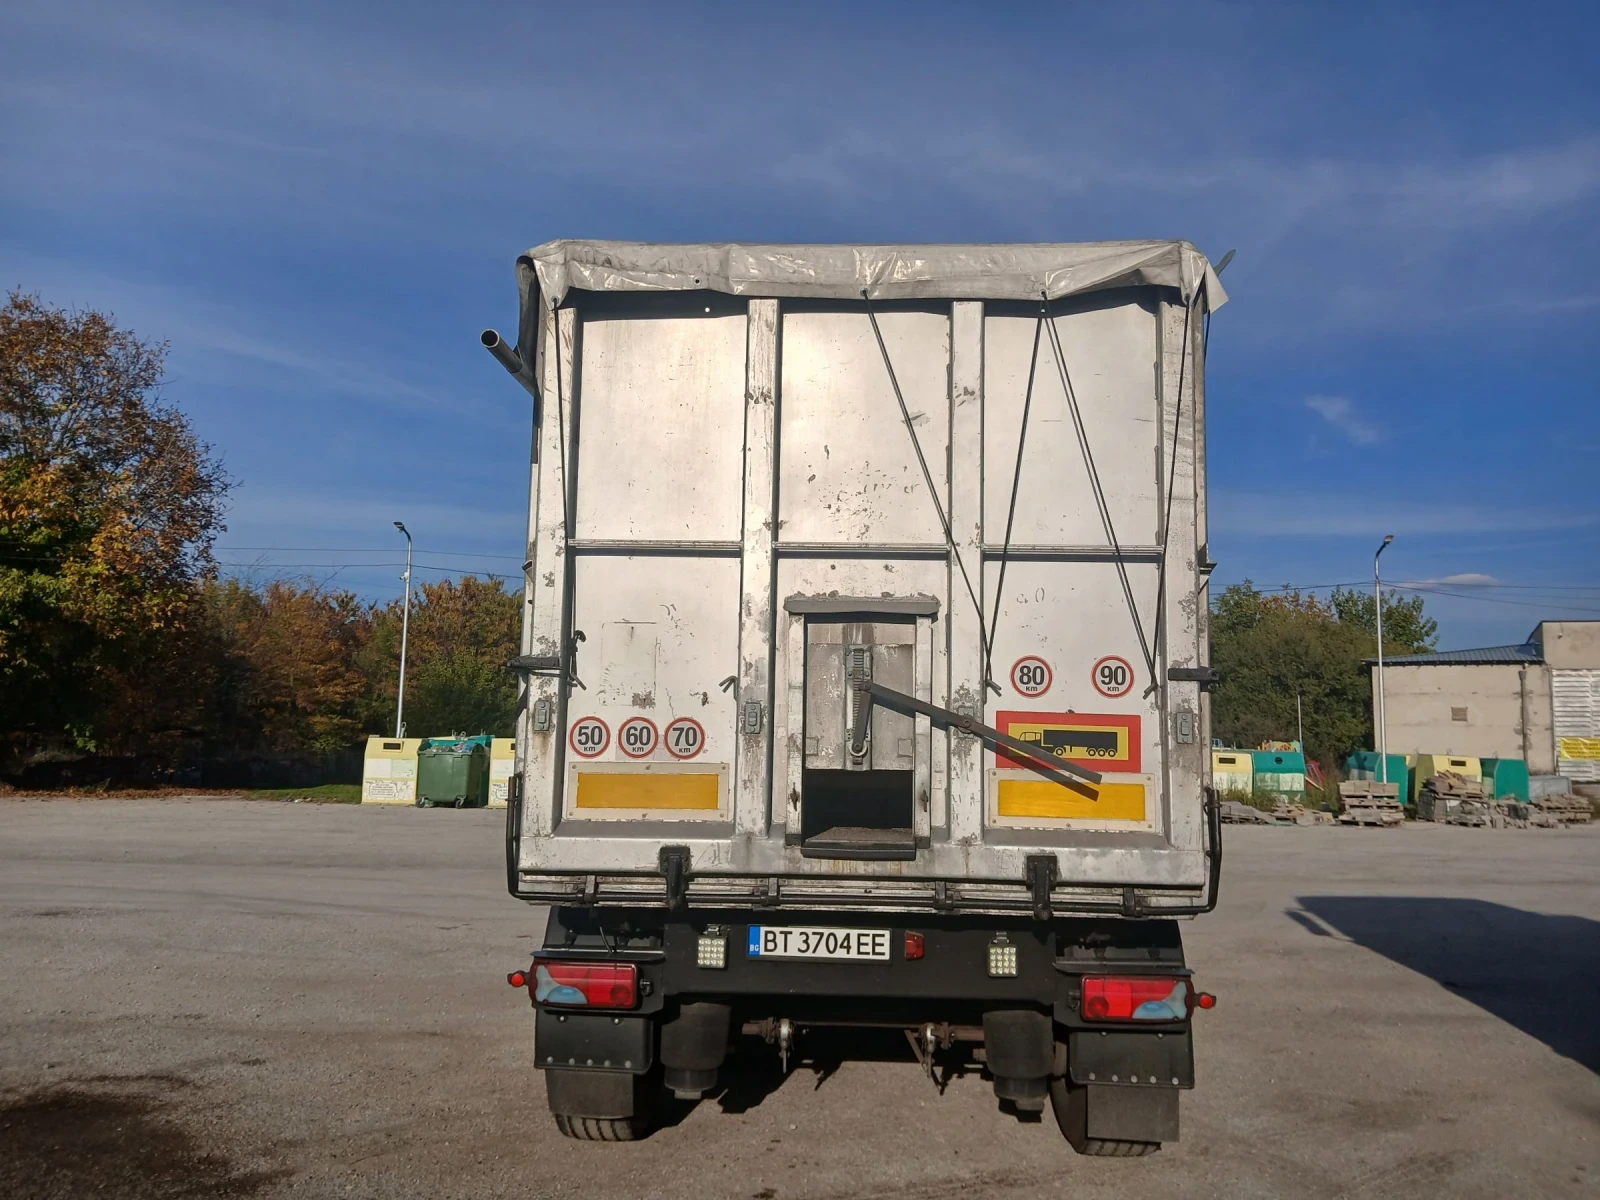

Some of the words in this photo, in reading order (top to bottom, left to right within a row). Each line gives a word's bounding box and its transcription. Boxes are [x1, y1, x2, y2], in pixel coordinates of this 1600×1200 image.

[1019, 665, 1045, 686] 80
[1100, 665, 1127, 686] 90
[577, 726, 603, 746] 50
[625, 726, 651, 746] 60
[672, 727, 698, 747] 70
[763, 930, 793, 953] BT
[797, 931, 852, 955] 3704
[856, 933, 886, 956] EE
